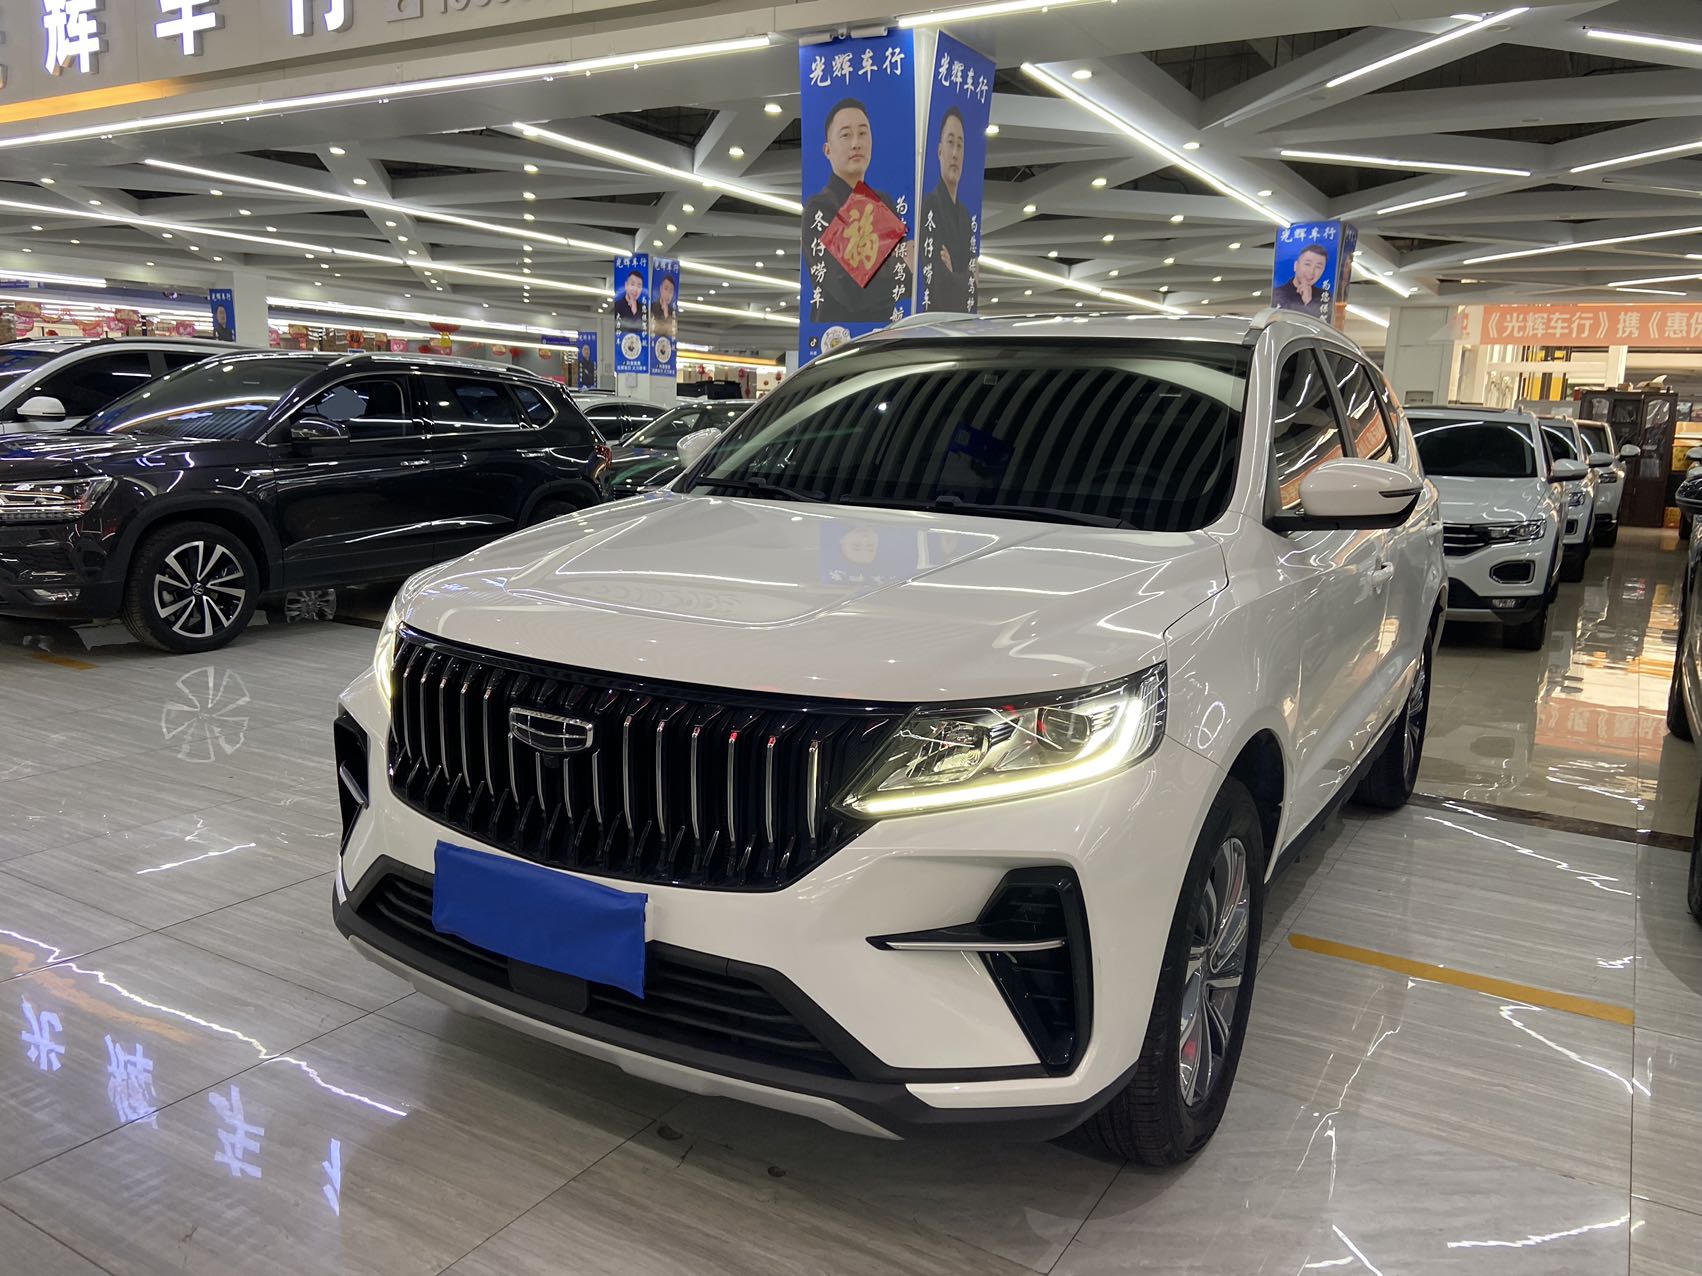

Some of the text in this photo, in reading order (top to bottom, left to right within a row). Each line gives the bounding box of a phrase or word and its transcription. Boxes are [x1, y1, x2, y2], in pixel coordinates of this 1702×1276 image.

[808, 47, 905, 87] 光辉车行
[936, 52, 988, 104] 光辉车行
[810, 210, 829, 309] 冬仔唠车
[842, 202, 880, 269] 福
[889, 195, 908, 322] 为保驾护航
[922, 210, 936, 311] 冬仔唠车
[1280, 226, 1336, 243] 光辉车行
